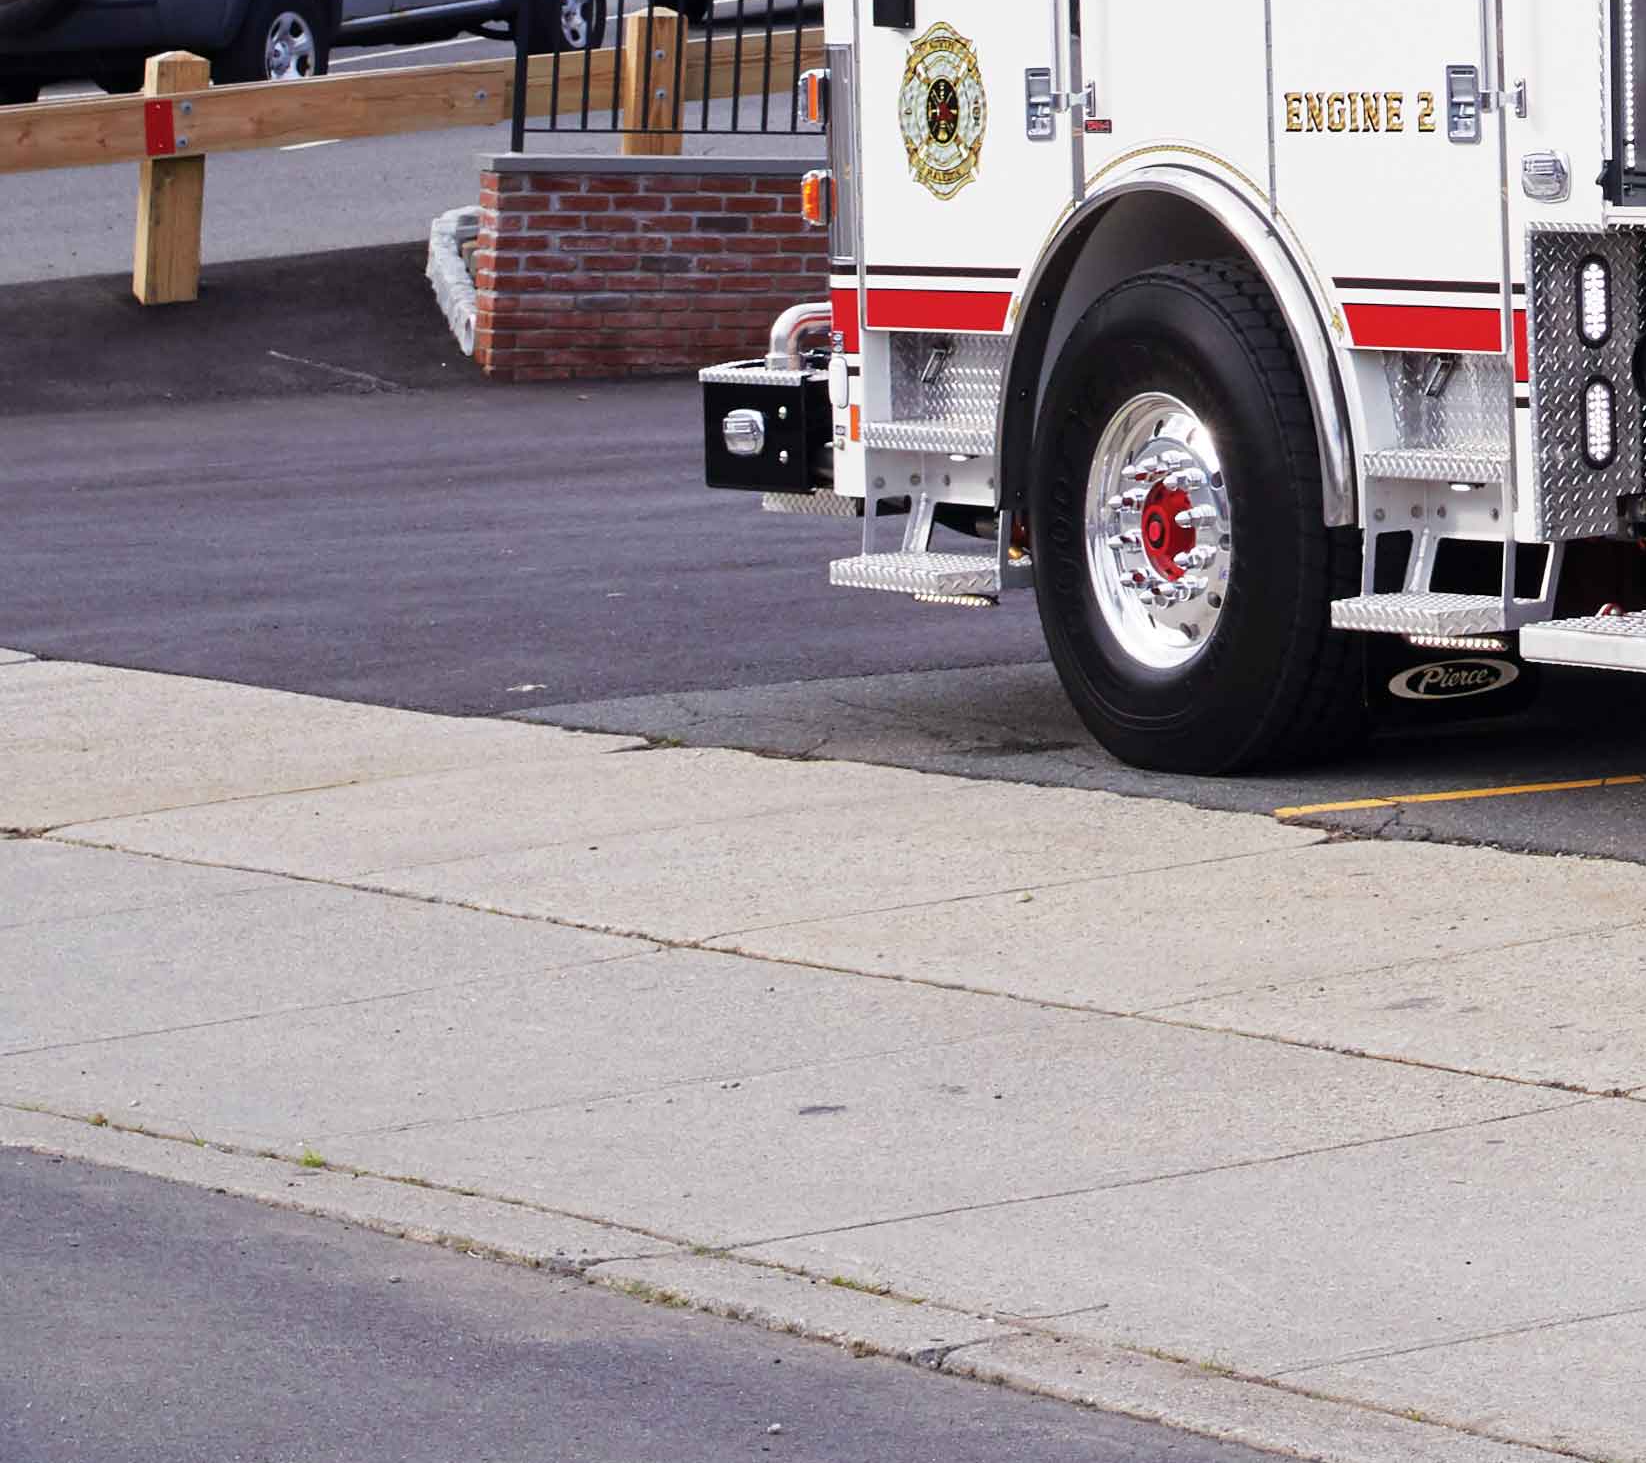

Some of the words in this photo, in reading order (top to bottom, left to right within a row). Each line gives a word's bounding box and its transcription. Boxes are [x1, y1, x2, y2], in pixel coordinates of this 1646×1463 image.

[1284, 91, 1404, 133] ENGINE
[1417, 91, 1436, 133] 2
[1417, 666, 1489, 694] Pierce
